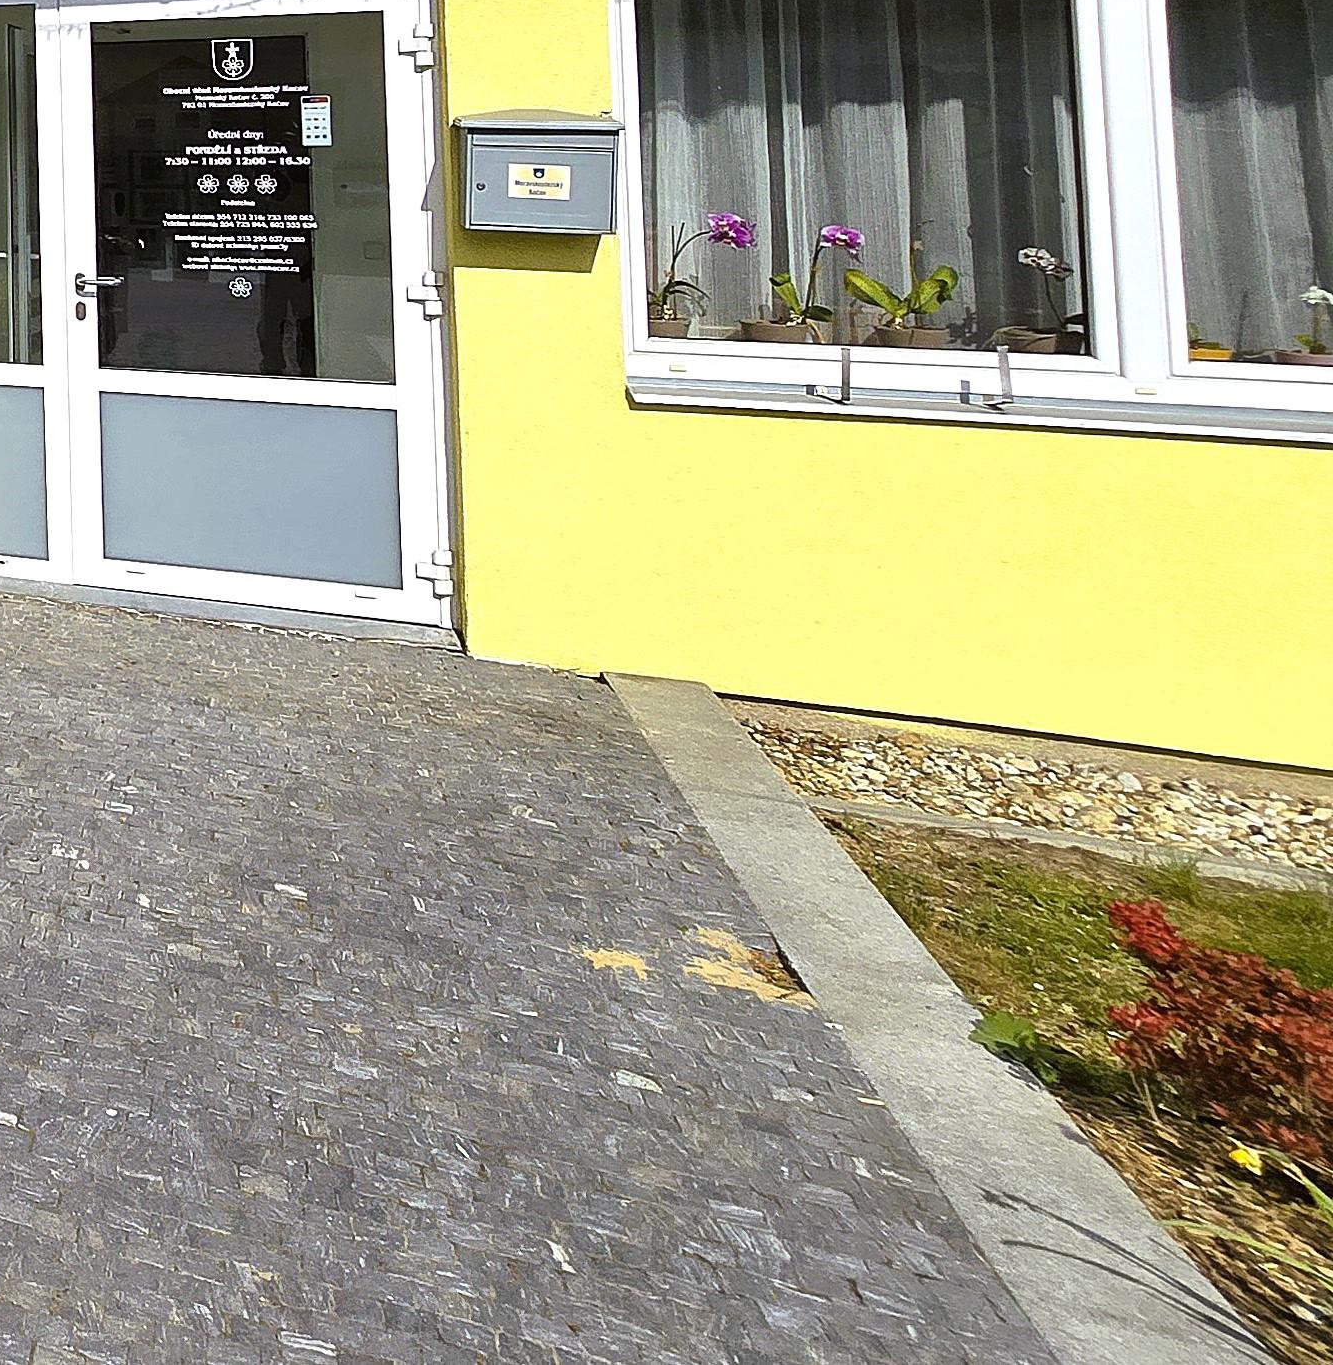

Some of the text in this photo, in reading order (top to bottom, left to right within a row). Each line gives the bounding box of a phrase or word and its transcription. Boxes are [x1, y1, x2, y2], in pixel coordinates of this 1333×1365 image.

[208, 129, 241, 139] Úřední
[186, 144, 231, 155] PONDĚLÍ
[244, 144, 287, 155] STŘEDA
[202, 157, 232, 166] 11:00
[236, 157, 266, 165] 12:00
